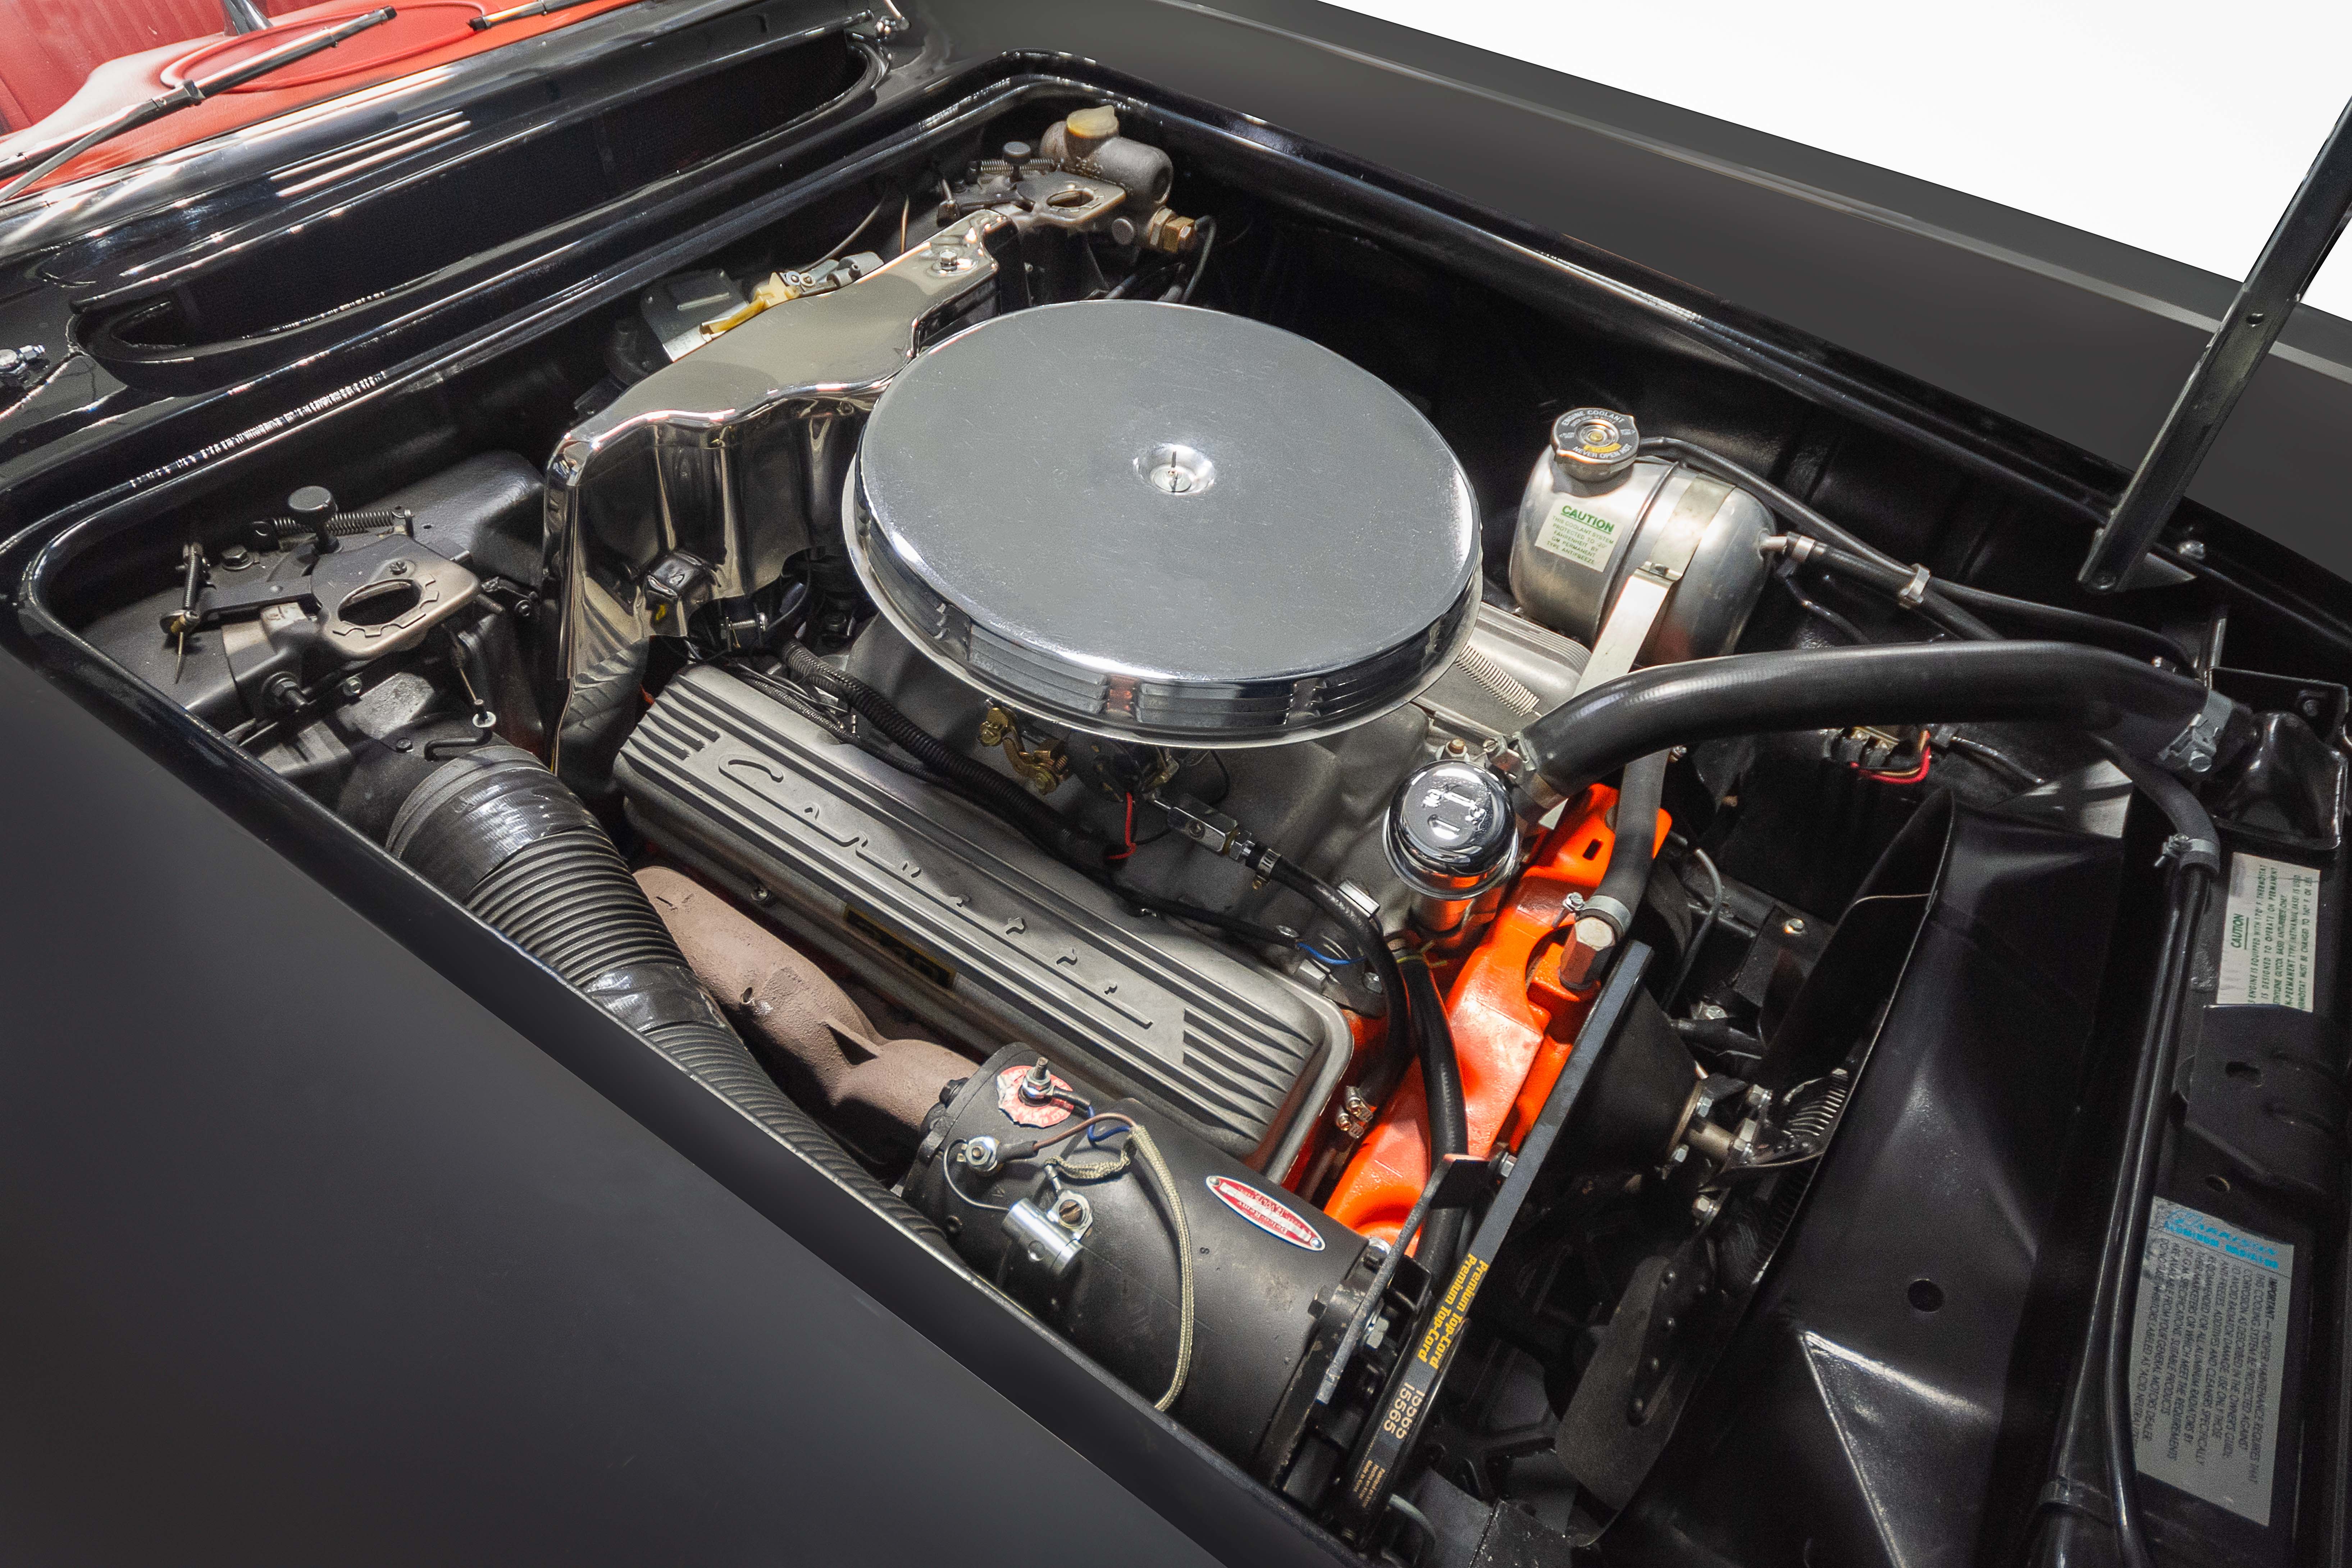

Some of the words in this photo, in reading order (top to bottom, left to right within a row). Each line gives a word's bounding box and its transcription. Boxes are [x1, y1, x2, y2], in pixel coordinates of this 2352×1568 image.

[1562, 411, 1586, 426] ENGINE
[1587, 410, 1624, 423] COOLANT
[1573, 446, 1597, 458] NEVER
[1619, 443, 1632, 454] HOT
[1553, 523, 1585, 539] PROTECTED
[1562, 505, 1615, 533] CAUTION
[1554, 530, 1588, 547] FAHRENHEIT
[1565, 521, 1592, 534] COOLANT
[1592, 531, 1614, 544] SYSTEM
[1547, 541, 1559, 550] TYPE
[1561, 548, 1595, 565] ANTIFREEZE
[1562, 541, 1595, 557] PERMANENT
[2256, 864, 2267, 899] THERMOSTAT
[2268, 867, 2278, 901] PERMANENT
[2303, 888, 2311, 896] OR
[2267, 903, 2275, 912] ON
[2230, 913, 2244, 949] CAUTION
[2253, 921, 2262, 936] WITH
[2264, 915, 2274, 942] OPERATE
[2276, 909, 2287, 938] ANTI-FREEZE
[2250, 937, 2261, 966] EQUIPPED
[2264, 945, 2272, 954] TO
[2287, 944, 2296, 958] TYPE
[2300, 927, 2309, 953] CHANGED
[2261, 957, 2271, 989] DESIGNED
[2274, 957, 2283, 977] GLYCOL
[2298, 963, 2307, 978] MUST
[2247, 974, 2258, 998] ENGINE
[1253, 1194, 1276, 1211] VOLTS
[1275, 1207, 1285, 1217] 12
[1235, 1199, 1288, 1234] Delco-Remy
[2159, 1237, 2169, 1251] DO
[2170, 1241, 2181, 1257] ARE
[2183, 1246, 2194, 1259] OF
[2157, 1250, 2168, 1268] NOT
[2193, 1249, 2205, 1272] THEIR
[2231, 1263, 2241, 1276] TO
[1445, 1253, 1478, 1305] Premium
[1457, 1260, 1489, 1312] Premium
[2154, 1266, 2165, 1282] USE
[2165, 1255, 2179, 1296] AVAILABLE
[2200, 1253, 2216, 1315] RECOMMENDED
[2255, 1272, 2266, 1289] THIS
[2187, 1270, 2202, 1316] MARKETERS
[2228, 1275, 2240, 1301] AVOID
[2239, 1267, 2253, 1316] CORROSION
[2264, 1276, 2278, 1321] IMPORTANT
[2148, 1280, 2163, 1323] INHIBITORS
[2162, 1294, 2173, 1318] FROM
[2251, 1288, 2264, 1328] COOLING
[2157, 1316, 2169, 1340] YOUR
[2185, 1314, 2196, 1329] OR
[2198, 1313, 2209, 1331] FOR
[2210, 1308, 2223, 1349] ADDITIVES
[2224, 1299, 2237, 1338] RADIATOR
[2238, 1314, 2248, 1326] AS
[1416, 1305, 1451, 1363] Top-Cord
[1429, 1312, 1463, 1370] Top-Cord
[2142, 1321, 2156, 1357] LABELED
[2182, 1328, 2194, 1359] WHICH
[2196, 1330, 2206, 1345] ALL
[2247, 1326, 2260, 1357] SYSTEM
[2260, 1329, 2272, 1363] PROPER
[2152, 1337, 2166, 1376] GENERAL
[2167, 1337, 2180, 1373] SUITABLE
[2208, 1347, 2219, 1368] AND
[2233, 1325, 2247, 1370] DESCRIBED
[2139, 1354, 2151, 1368] AS
[2179, 1357, 2190, 1381] MEET
[2191, 1344, 2204, 1389] ALUMINUM
[2232, 1367, 2242, 1379] IN
[2246, 1355, 2256, 1367] BE
[2146, 1373, 2160, 1411] MOTORS
[2160, 1370, 2175, 1417] PRODUCTS
[2176, 1380, 2187, 1396] THE
[2202, 1366, 2216, 1410] CLEANERS
[2217, 1374, 2229, 1391] USE
[2230, 1377, 2241, 1394] THE
[2241, 1366, 2255, 1414] PROTECTED
[2253, 1361, 2269, 1422] MAINTENANCE
[1383, 1382, 1415, 1432] 15565
[2184, 1386, 2199, 1434] RADIATORS
[2215, 1389, 2227, 1414] ONLY
[2226, 1393, 2239, 1432] OWNER'S
[1396, 1391, 1425, 1440] 15565
[2166, 1394, 2185, 1463] REQUIREMENTS
[2211, 1413, 2224, 1441] THOSE
[2183, 1432, 2194, 1445] BY
[2195, 1407, 2211, 1467] SPECIFICALLY
[2237, 1413, 2251, 1452] AGAINST
[2249, 1421, 2263, 1463] REQUIRES
[2247, 1461, 2259, 1485] THAT
